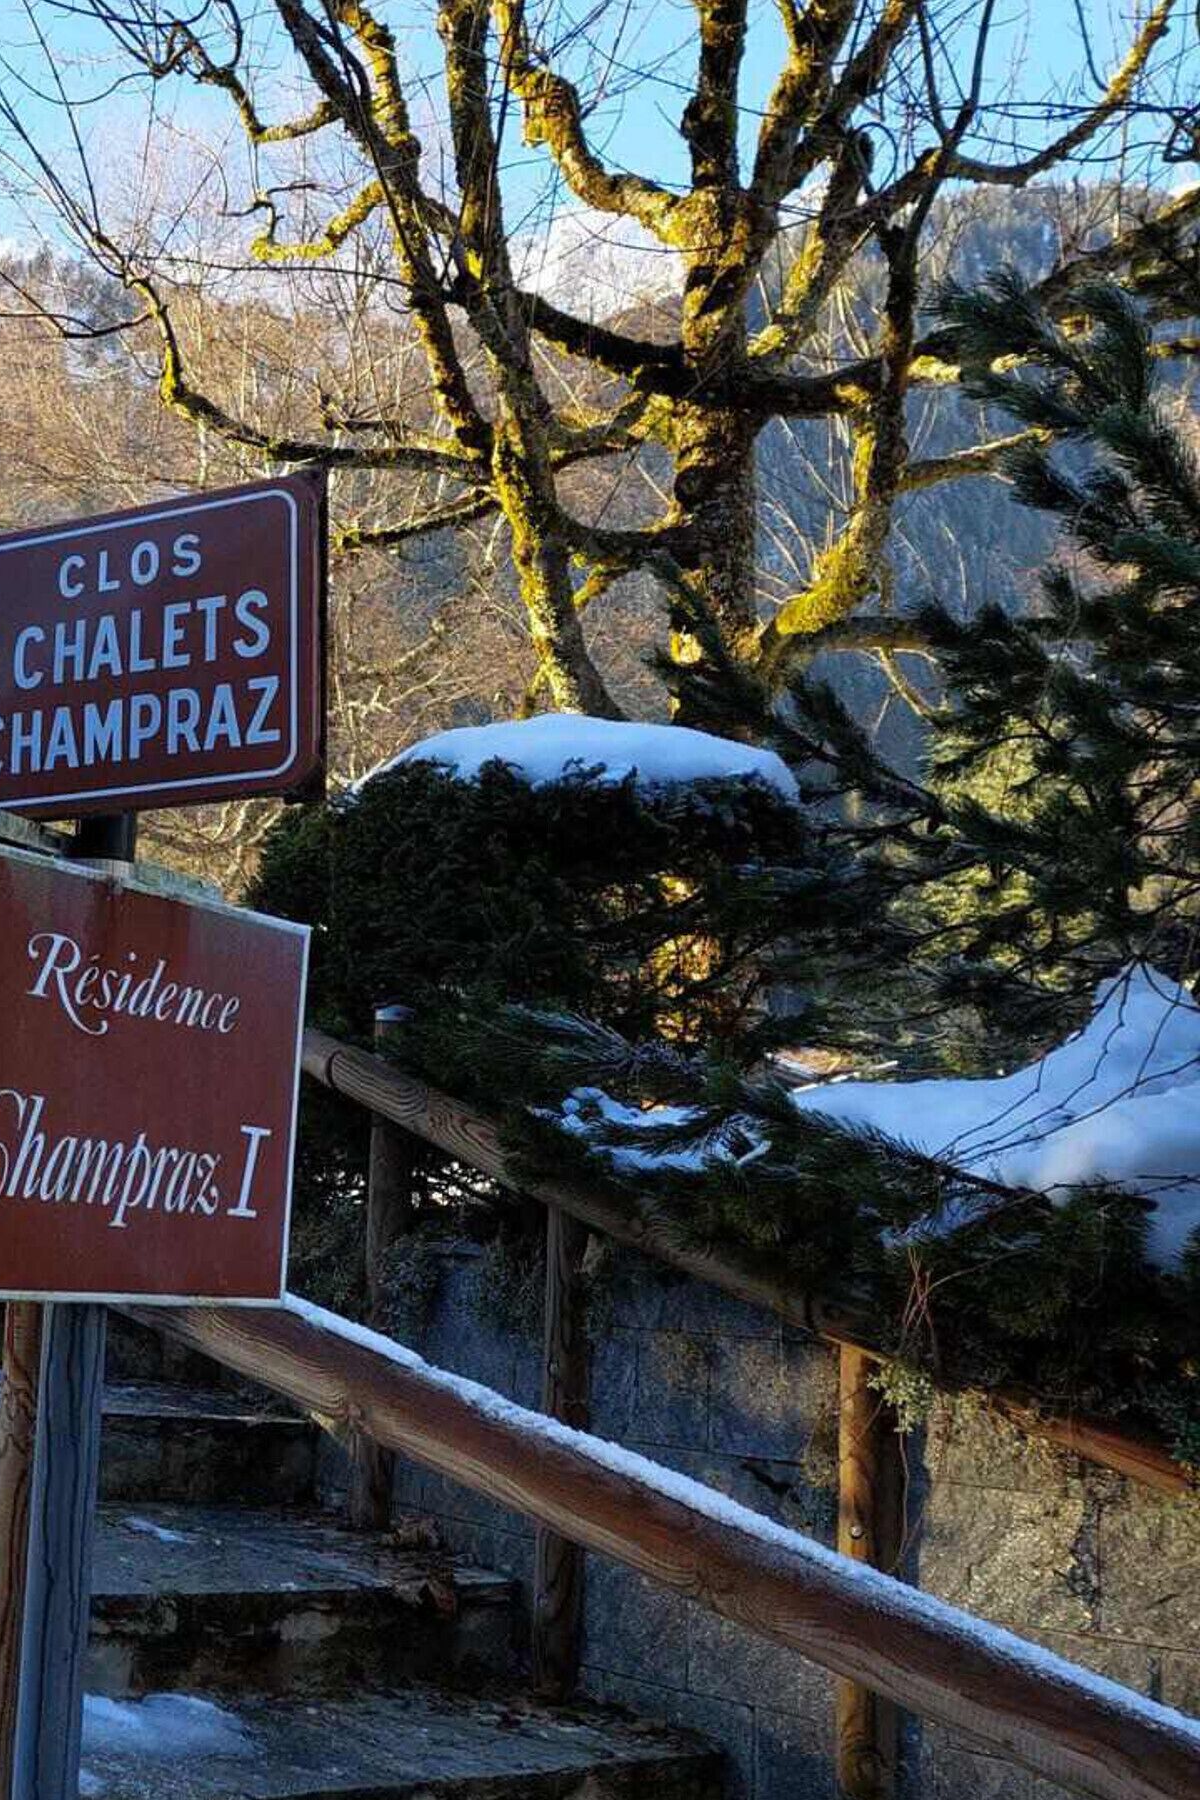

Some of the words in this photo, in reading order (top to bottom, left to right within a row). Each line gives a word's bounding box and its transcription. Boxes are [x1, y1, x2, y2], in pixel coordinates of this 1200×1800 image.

[58, 533, 201, 599] CLOS
[13, 589, 271, 690] CHALETS
[26, 933, 241, 1035] Résidence
[226, 1125, 272, 1219] I
